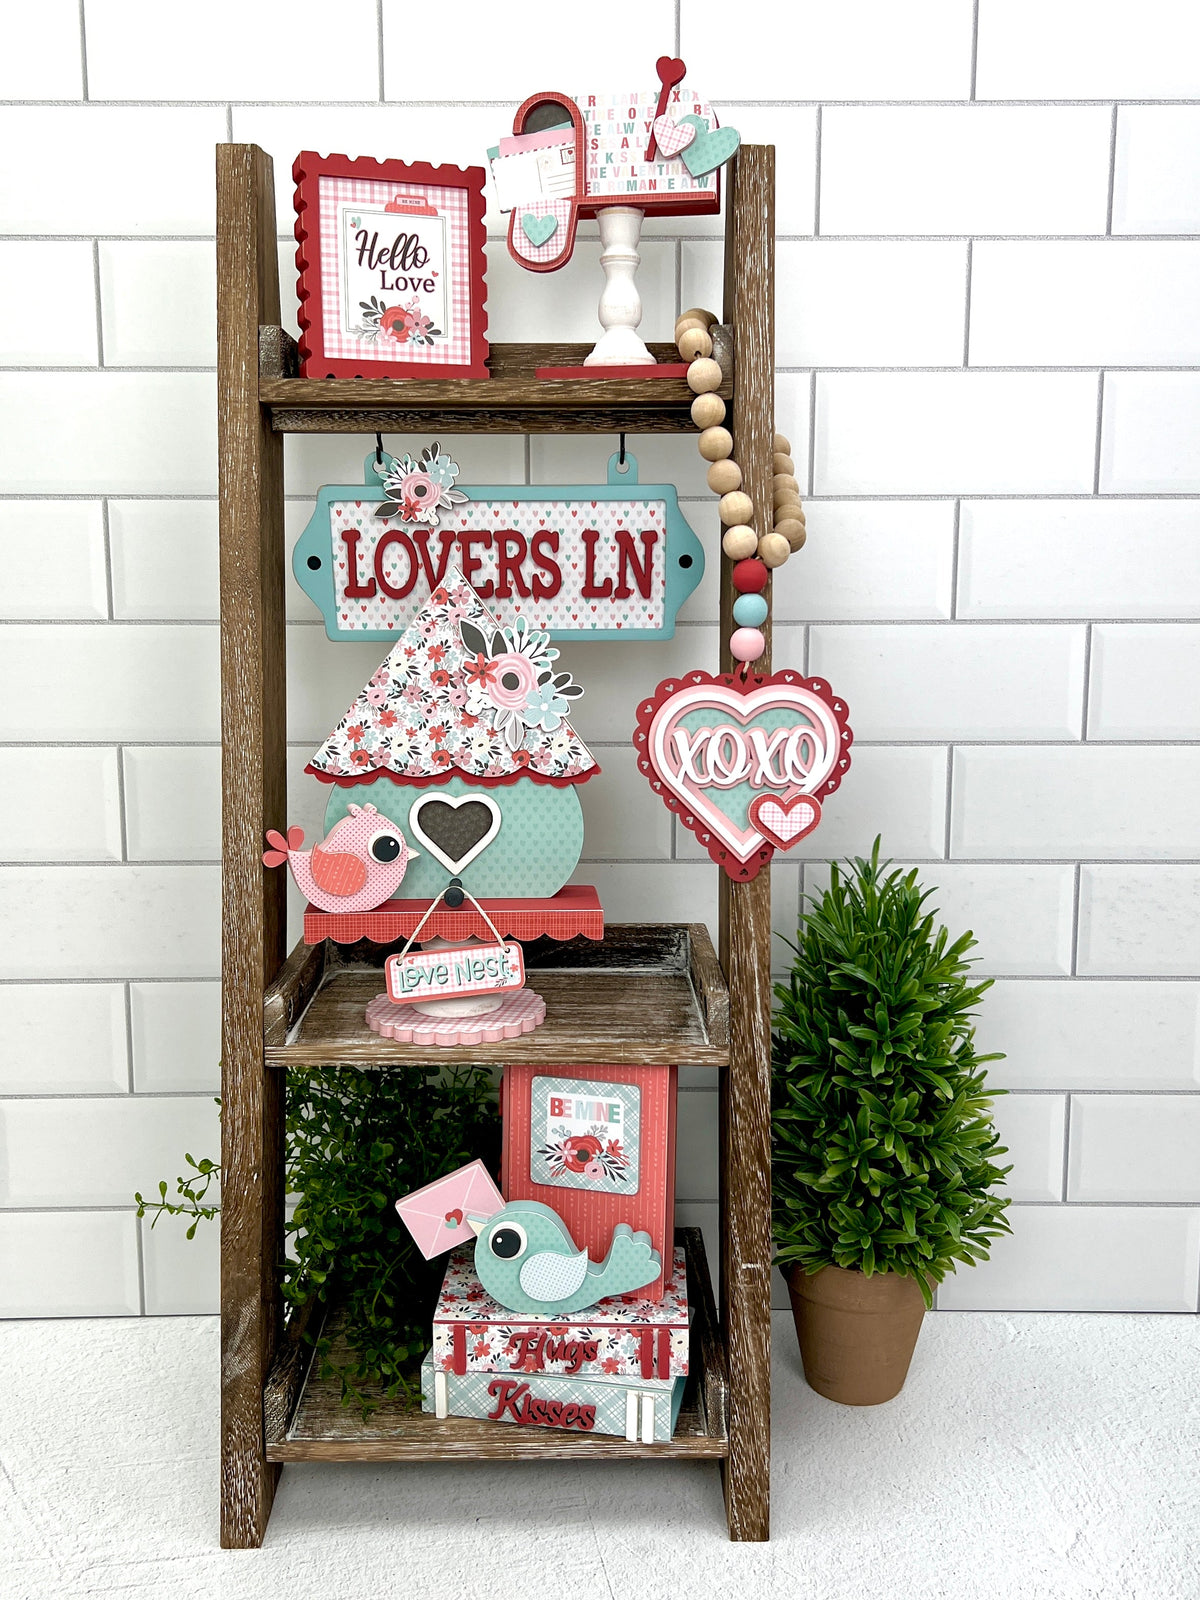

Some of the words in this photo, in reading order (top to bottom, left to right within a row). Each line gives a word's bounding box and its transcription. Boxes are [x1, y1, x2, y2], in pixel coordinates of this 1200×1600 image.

[612, 92, 647, 105] LANE
[653, 90, 699, 104] XXOX
[584, 108, 615, 121] TINE
[693, 104, 710, 115] BE
[620, 137, 630, 149] A
[613, 163, 689, 178] VALENTINE
[608, 178, 675, 192] ROMANCE
[355, 229, 430, 272] Hello
[380, 270, 436, 293] Love
[341, 529, 562, 600] LOVERS
[581, 529, 659, 600] LN
[399, 964, 448, 993] Love
[455, 954, 509, 985] Nest
[549, 1096, 573, 1119] BE
[575, 1100, 621, 1124] MINE
[509, 1330, 600, 1374] Hugs
[487, 1379, 597, 1430] Kisses
